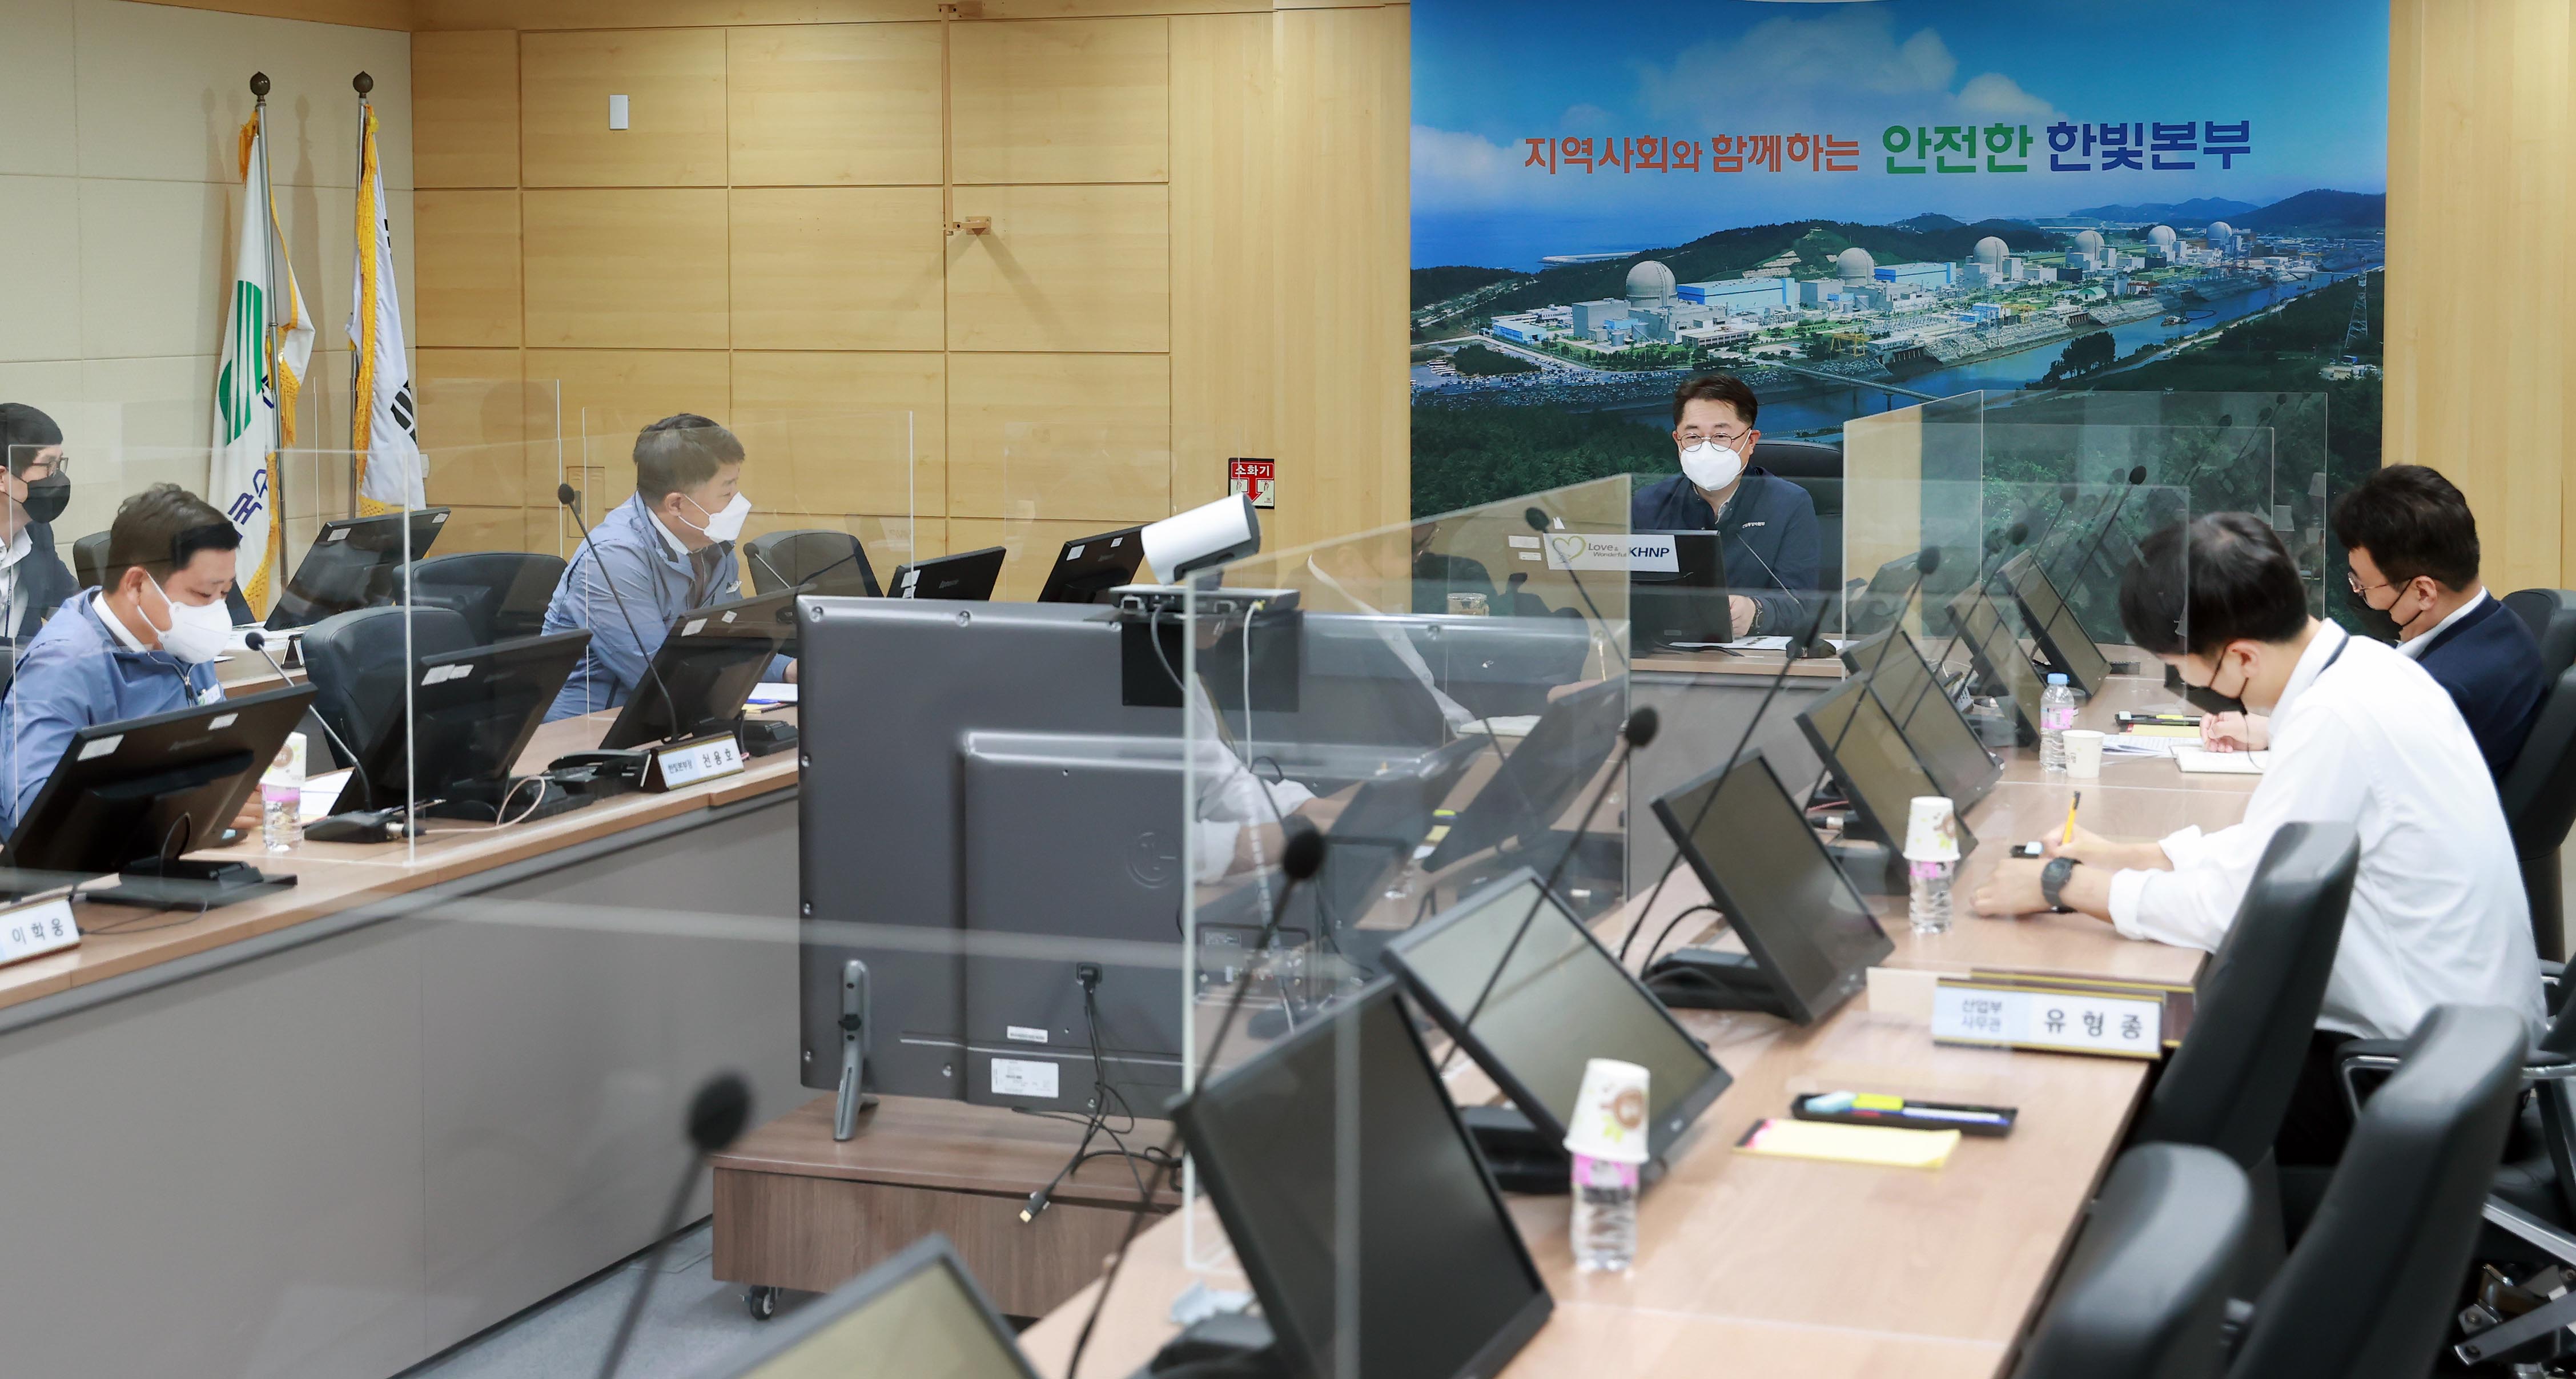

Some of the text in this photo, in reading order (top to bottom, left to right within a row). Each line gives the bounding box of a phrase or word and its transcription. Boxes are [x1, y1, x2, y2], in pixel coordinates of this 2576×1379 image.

[1525, 120, 2251, 174] 지역사회와 함께하는 안전한 한빛본부
[1235, 465, 1269, 476] 소화기
[1629, 546, 1670, 558] KHNP
